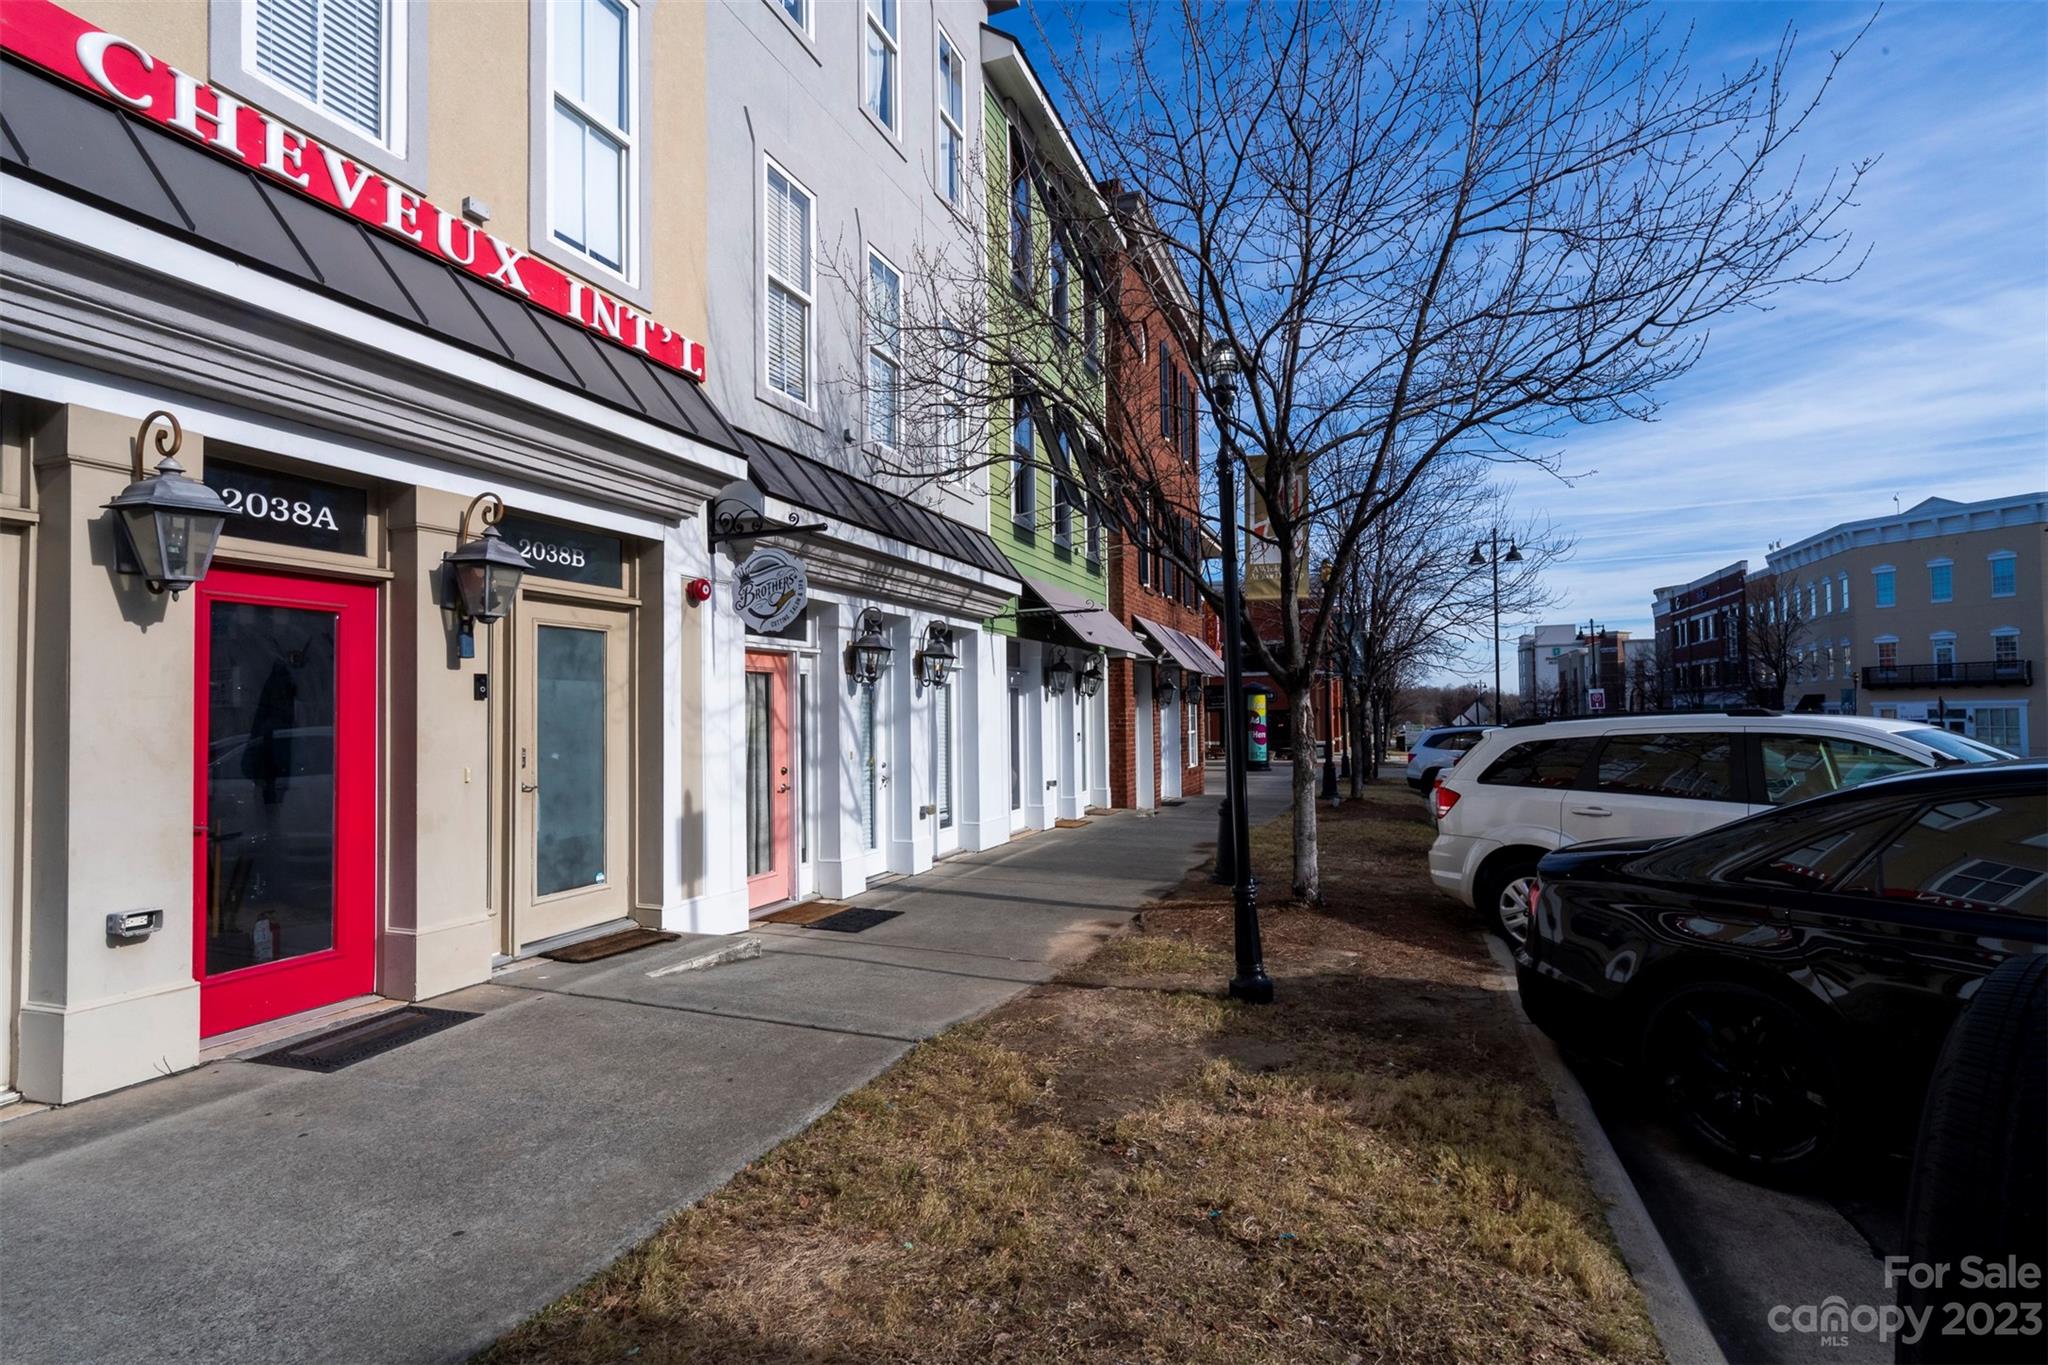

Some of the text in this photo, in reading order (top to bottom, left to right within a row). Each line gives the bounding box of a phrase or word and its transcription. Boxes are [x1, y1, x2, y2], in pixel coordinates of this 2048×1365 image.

[75, 30, 705, 380] CHEVEUX INT'L
[221, 487, 339, 531] 2038A
[519, 538, 586, 568] 2038B
[735, 573, 795, 611] BROTHERS
